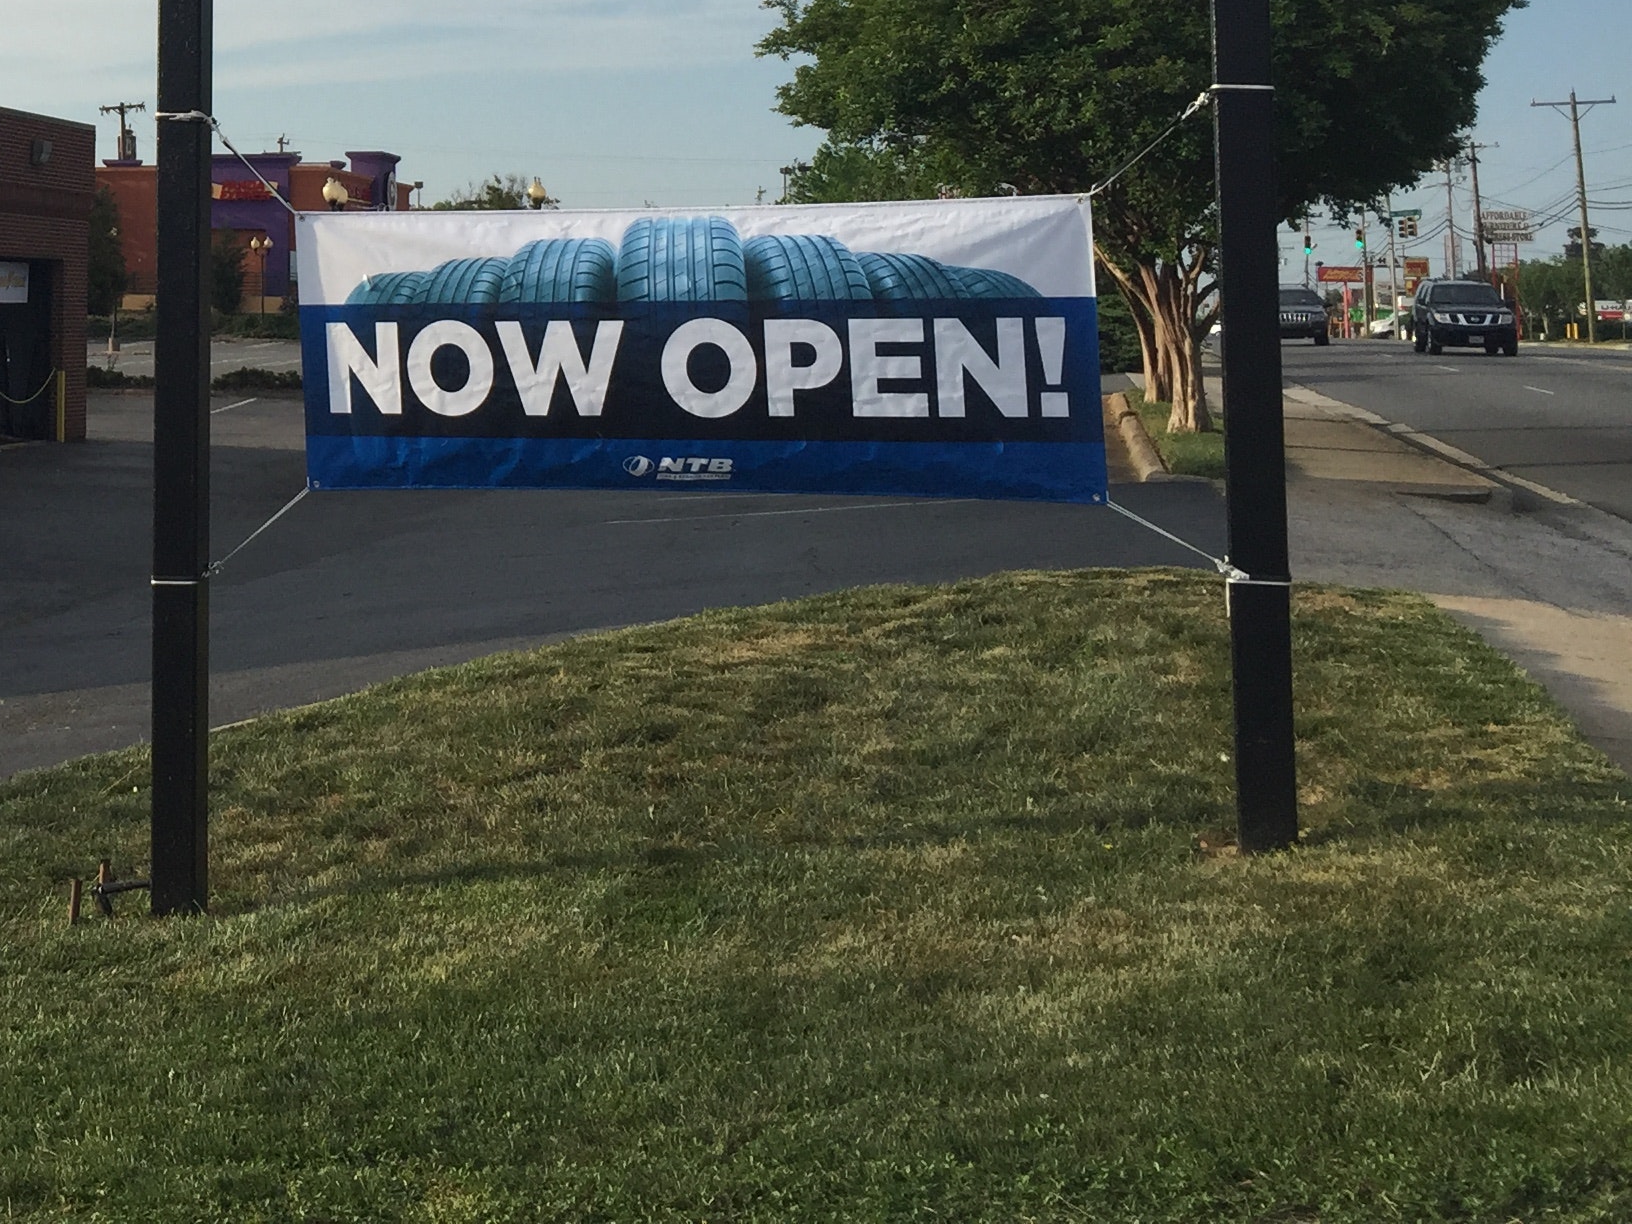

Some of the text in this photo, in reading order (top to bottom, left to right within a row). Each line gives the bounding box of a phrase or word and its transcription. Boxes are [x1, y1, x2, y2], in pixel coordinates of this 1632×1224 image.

[325, 316, 1071, 419] NOW OPEN!
[657, 456, 734, 473] NTB
